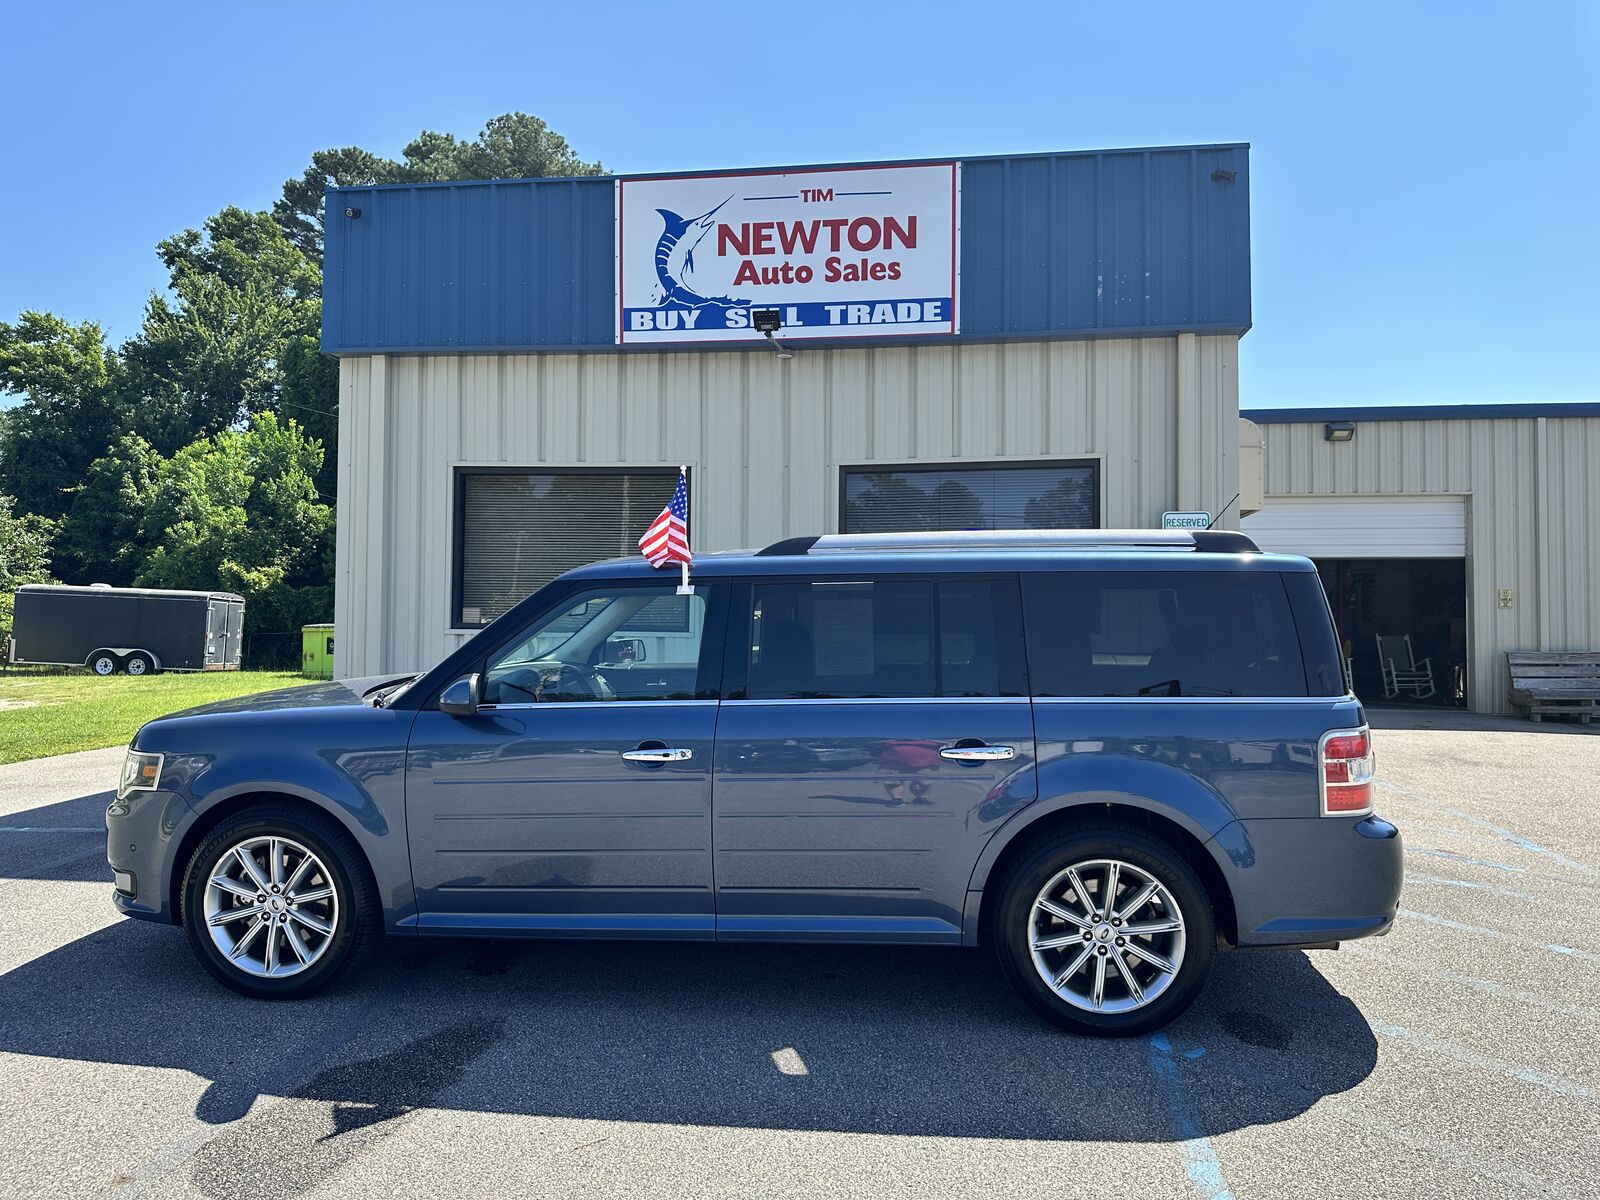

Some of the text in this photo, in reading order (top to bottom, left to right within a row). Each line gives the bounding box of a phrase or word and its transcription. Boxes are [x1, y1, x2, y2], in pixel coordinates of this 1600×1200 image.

[800, 188, 833, 203] TIM
[717, 215, 917, 257] NEWTON
[733, 256, 902, 286] Auto Sales
[630, 301, 942, 331] BUY SL TRADE
[1166, 518, 1207, 527] RESERVED
